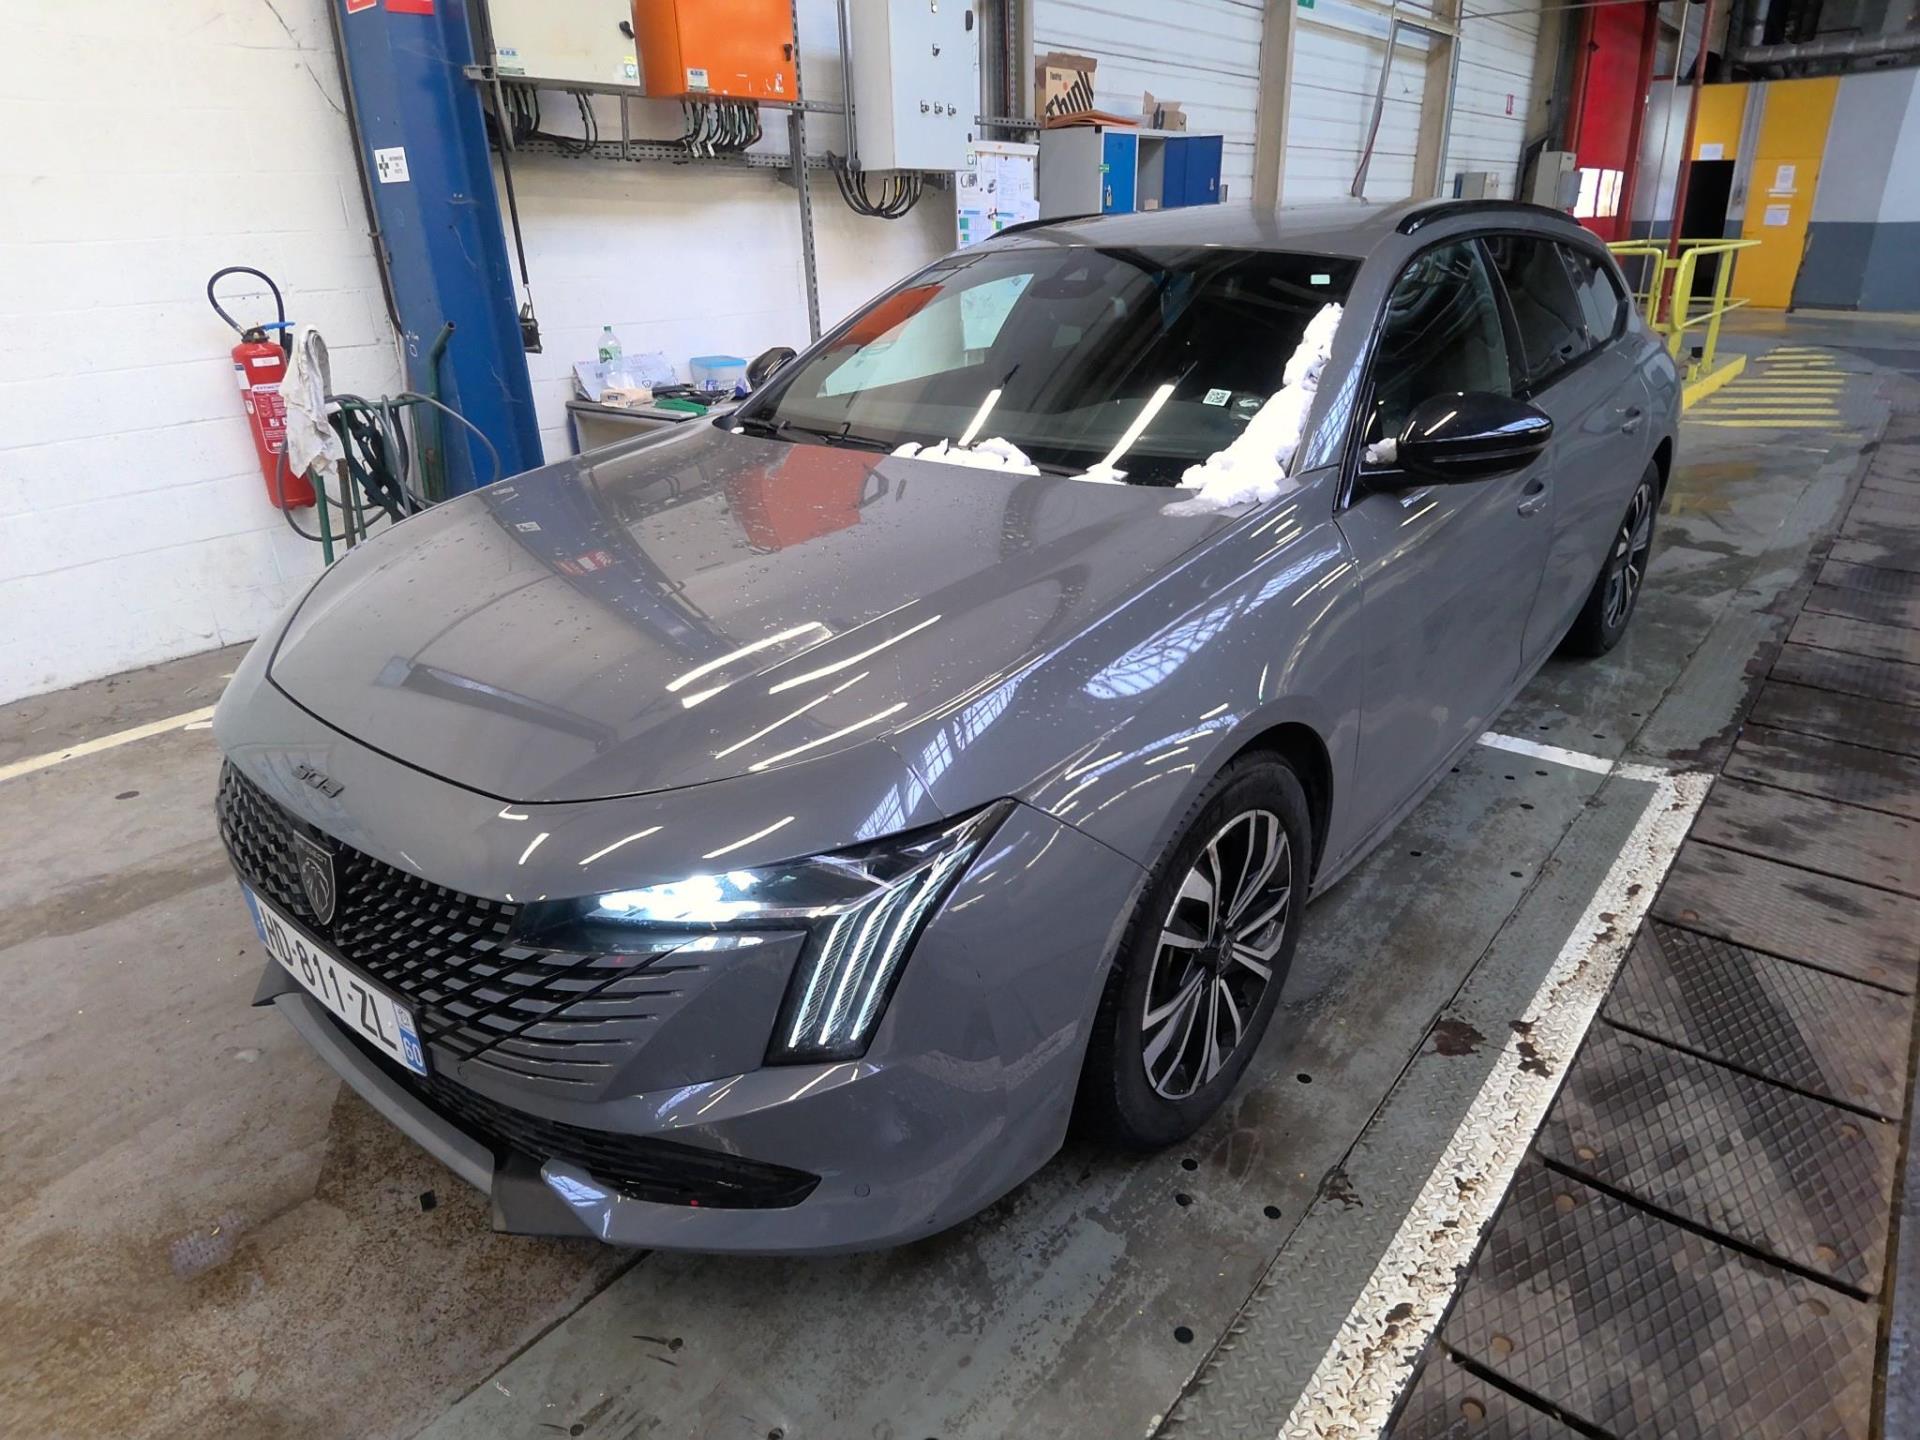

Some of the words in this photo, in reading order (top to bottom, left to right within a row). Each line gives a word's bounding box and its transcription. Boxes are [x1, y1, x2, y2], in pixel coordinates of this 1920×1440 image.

[293, 765, 344, 798] 508
[260, 905, 398, 1052] HD-811-ZL
[402, 1037, 423, 1068] 60
